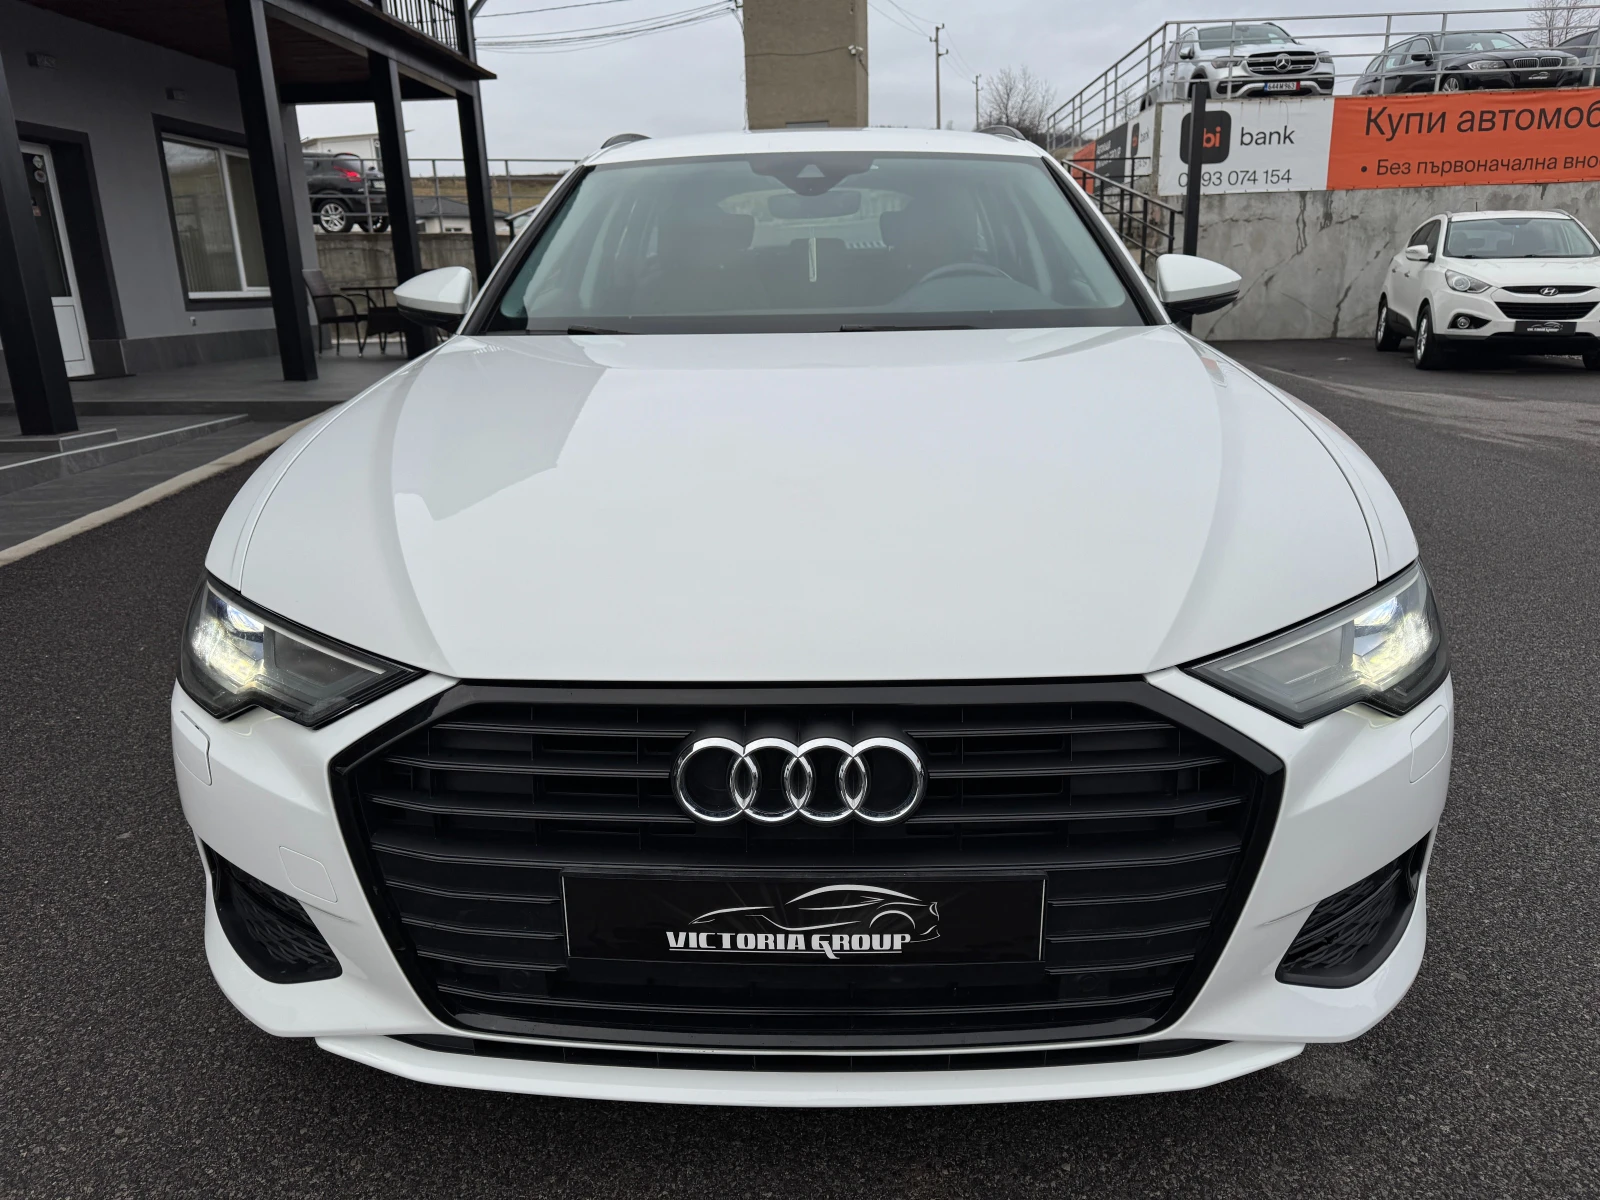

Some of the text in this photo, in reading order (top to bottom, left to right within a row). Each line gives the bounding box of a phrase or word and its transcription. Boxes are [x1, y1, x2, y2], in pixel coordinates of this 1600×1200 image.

[1365, 100, 1600, 142] Купи автомоб
[1240, 125, 1296, 146] bank
[1376, 155, 1600, 177] Без първоначална вно
[1178, 168, 1292, 187] 093 074 154
[666, 931, 911, 959] VICTORIA GROUP
